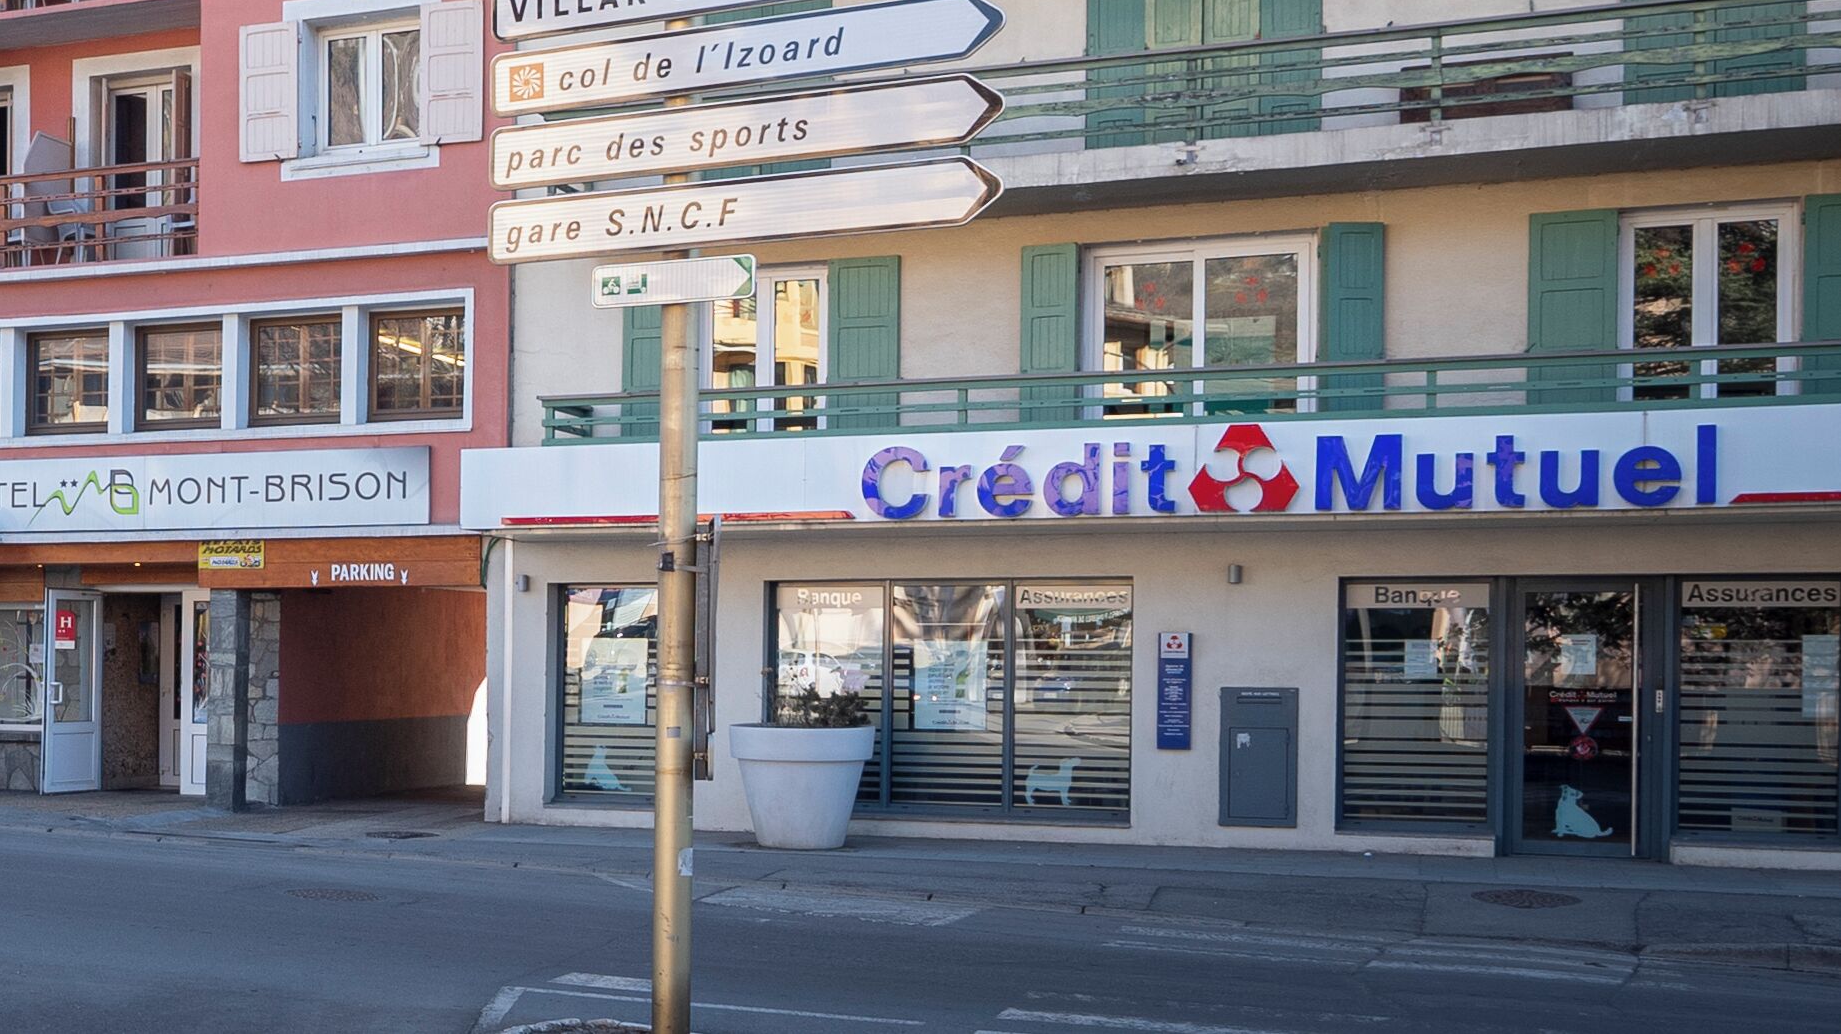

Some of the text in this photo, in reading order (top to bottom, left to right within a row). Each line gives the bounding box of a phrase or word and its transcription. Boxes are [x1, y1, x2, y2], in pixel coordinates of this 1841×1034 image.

[560, 59, 610, 92] col
[633, 52, 673, 83] de
[506, 116, 810, 178] parc des sports
[506, 198, 739, 253] gare S.N.C.F
[861, 424, 1718, 520] Crédit Mutuel
[149, 471, 408, 507] MONT-BRISON
[202, 545, 262, 554] MOTARDS
[331, 564, 395, 581] PARKING
[797, 588, 862, 608] Banque
[1020, 588, 1129, 605] Assurances
[1375, 586, 1461, 607] Banque
[1687, 583, 1838, 603] Assurances
[60, 616, 72, 628] H
